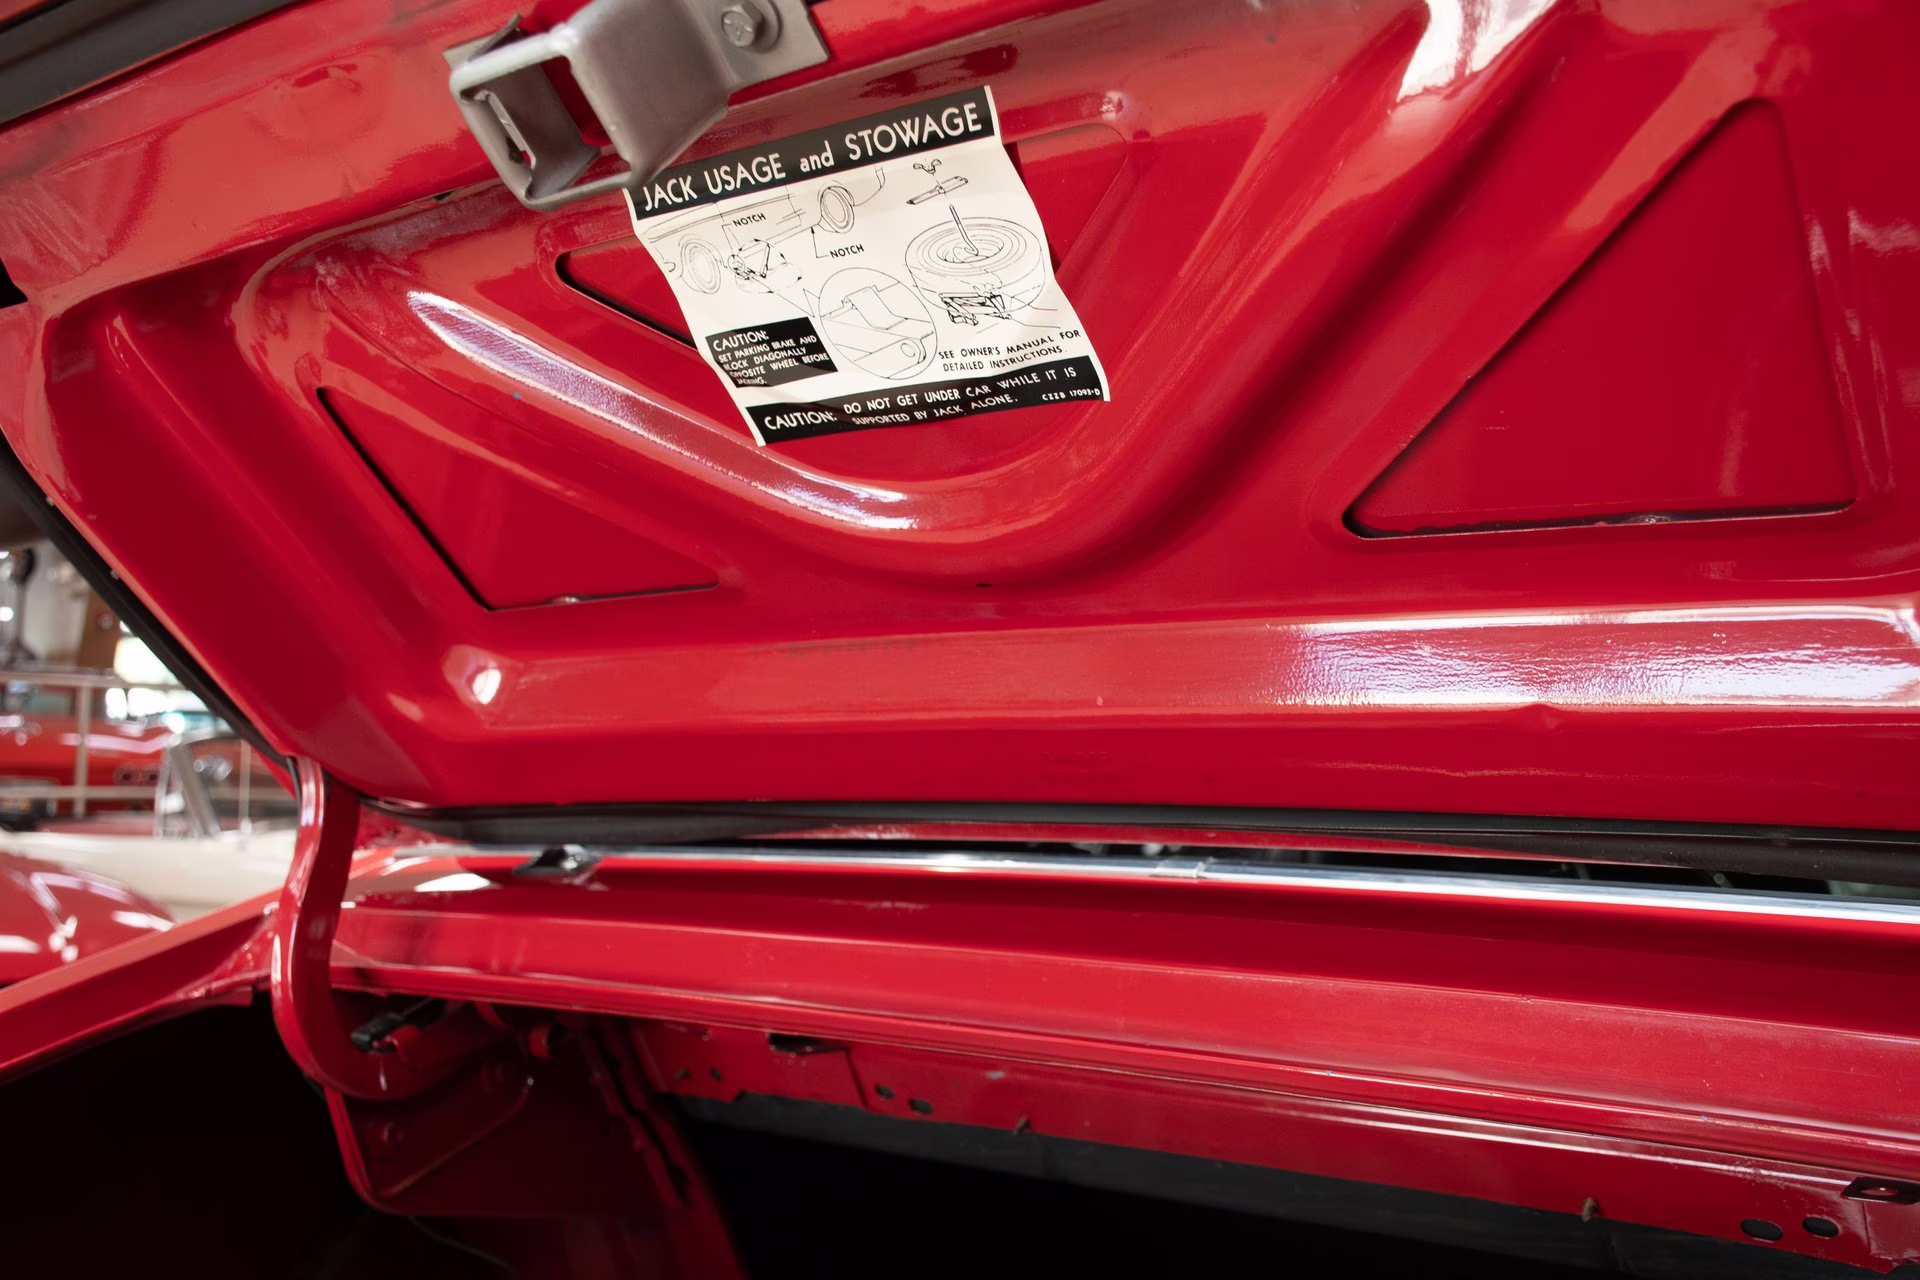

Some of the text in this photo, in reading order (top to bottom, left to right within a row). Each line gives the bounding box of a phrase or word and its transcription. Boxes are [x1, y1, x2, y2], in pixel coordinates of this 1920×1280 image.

[643, 102, 982, 211] JACK USAGE and STOWAGE
[732, 213, 767, 227] NOTCH
[829, 243, 866, 260] NOTCH
[713, 330, 770, 352] CAUTION:
[718, 335, 817, 363] SET PARKING BRAKE AND
[938, 329, 1082, 360] SEE OWNER'S MANUAL FOR
[723, 347, 807, 371] BLOCK DIAGONALLY
[769, 359, 800, 372] WHEEL
[801, 352, 830, 364] BEFORE
[942, 361, 985, 373] DETAILED
[843, 366, 1077, 415] DO NOT GET UNDER CAR WHILE IT IS
[764, 411, 839, 431] CAUTION:
[851, 393, 1018, 426] SUPPORTED BY JACK ALONE.
